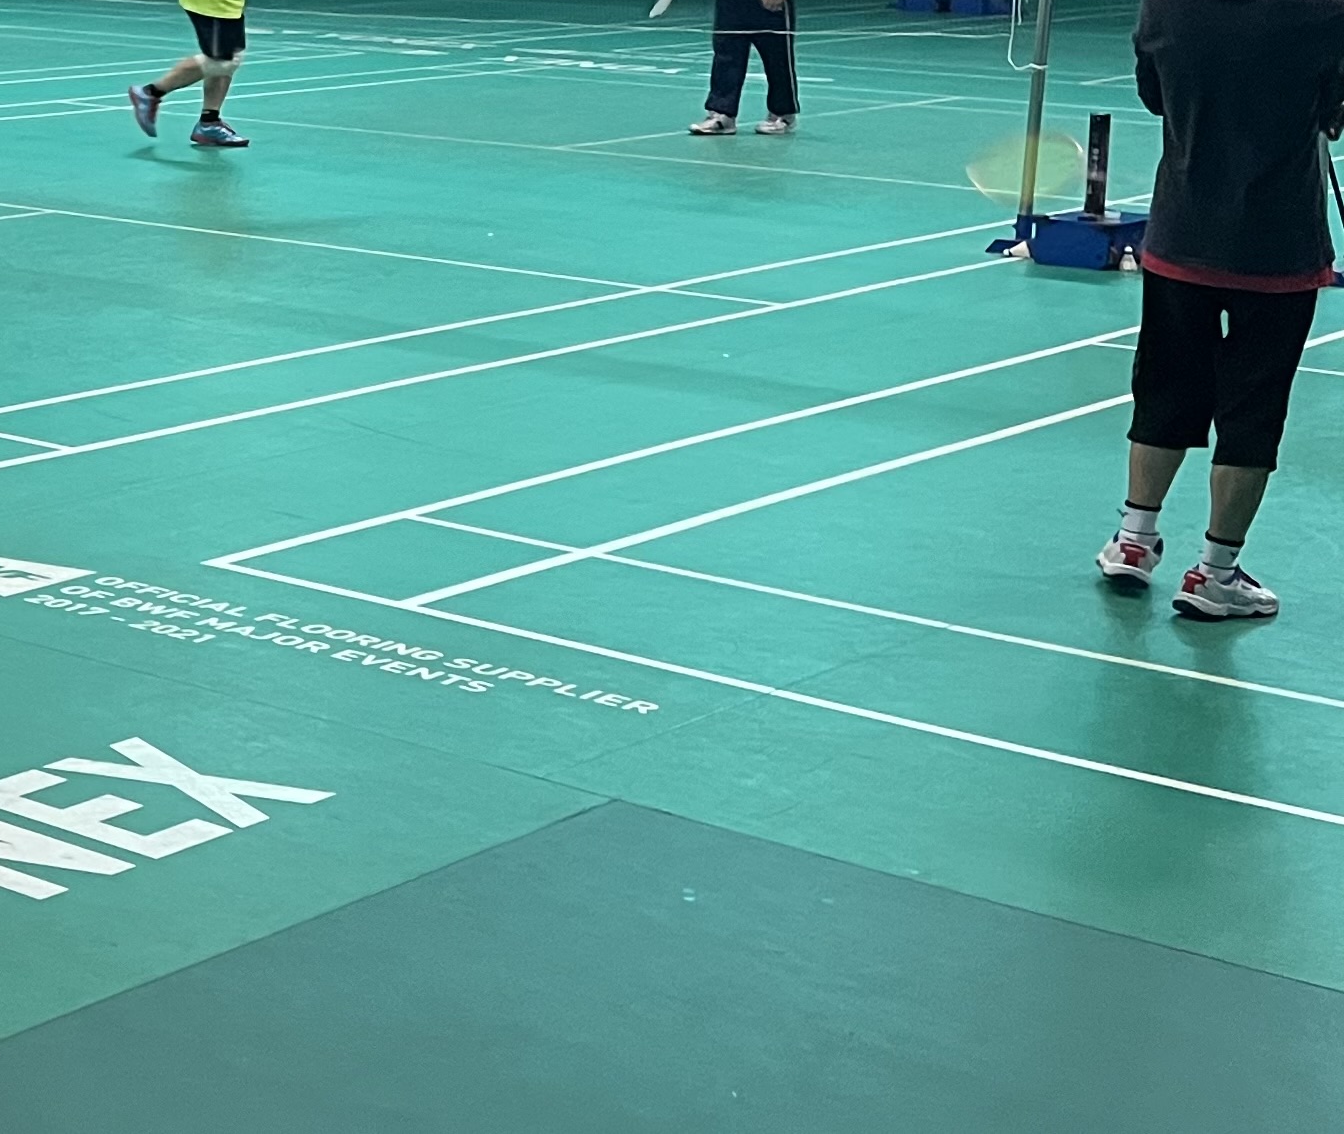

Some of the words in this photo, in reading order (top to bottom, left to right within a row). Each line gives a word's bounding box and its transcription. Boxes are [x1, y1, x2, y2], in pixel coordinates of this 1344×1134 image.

[23, 594, 110, 616] 2017
[128, 619, 217, 644] 2021
[60, 585, 115, 600] OF
[109, 597, 201, 620] BWF
[194, 616, 330, 654] MAJOR
[330, 649, 495, 693] EVENTS
[94, 576, 247, 617] OFFICIAL
[254, 613, 444, 661] FLOORING
[443, 658, 659, 715] SUPPLIER
